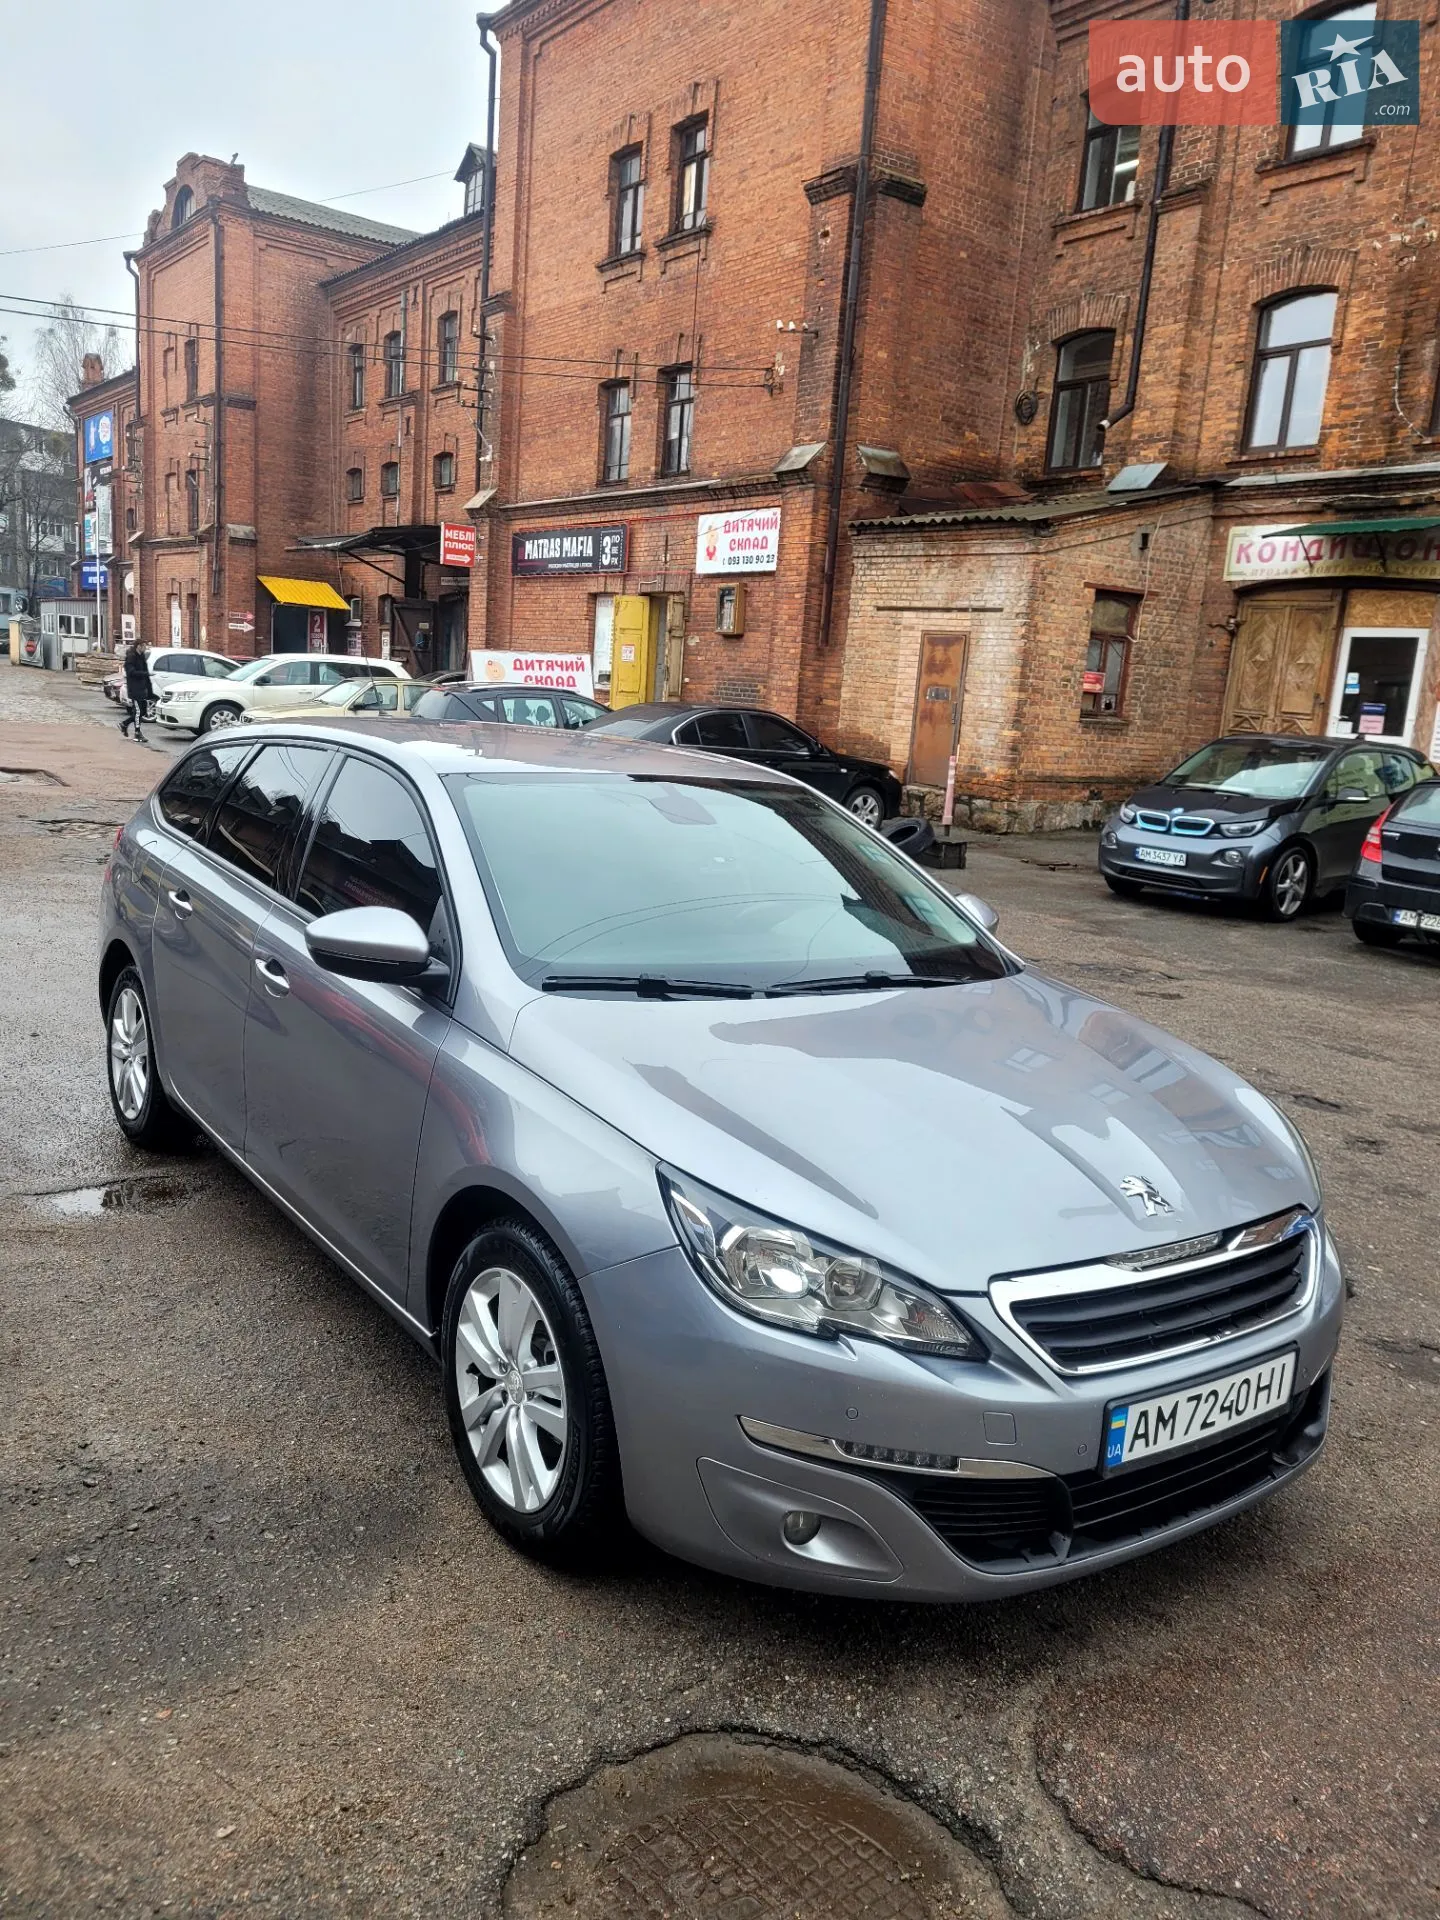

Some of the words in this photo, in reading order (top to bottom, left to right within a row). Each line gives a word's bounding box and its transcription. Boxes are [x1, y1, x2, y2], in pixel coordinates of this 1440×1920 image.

[723, 511, 778, 534] ДИТЯЧИЙ
[445, 529, 475, 541] МЕБЛІ
[445, 541, 474, 551] ПЛЮС
[524, 538, 561, 560] MATRAS
[562, 535, 593, 557] MAFIA
[602, 535, 611, 565] 3
[729, 536, 768, 552] СКЛАД
[513, 656, 585, 672] ДИТЯЧИЙ
[1107, 1445, 1122, 1459] UA
